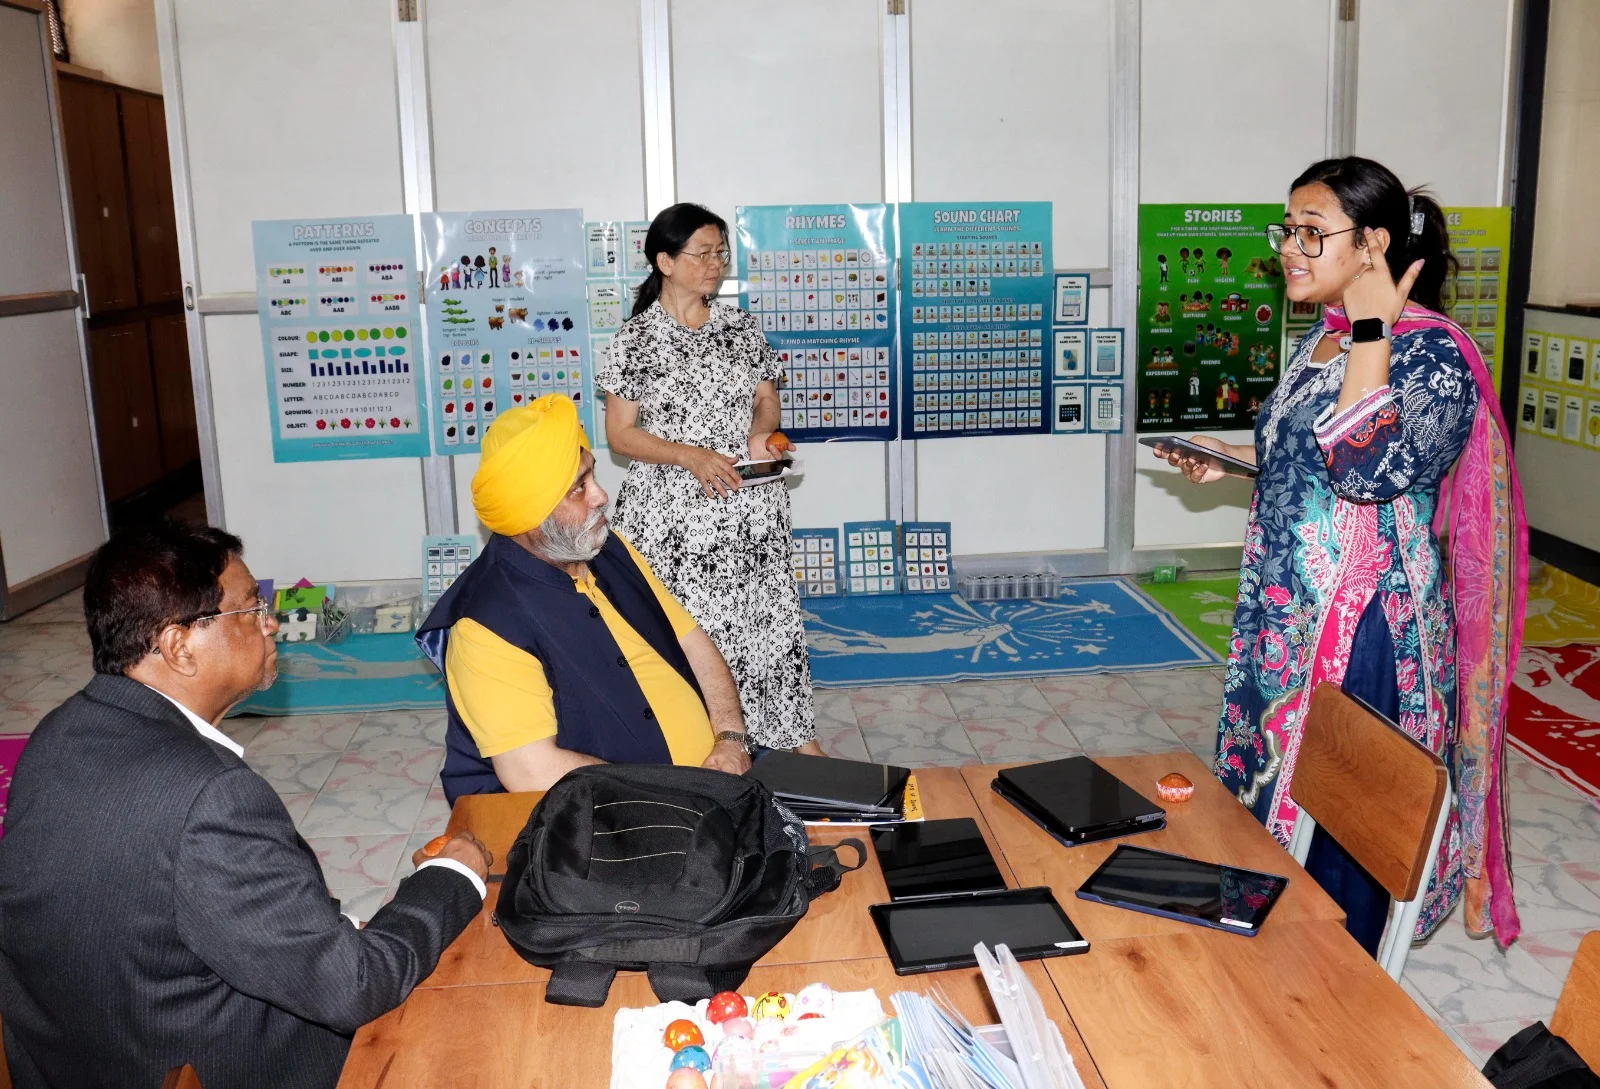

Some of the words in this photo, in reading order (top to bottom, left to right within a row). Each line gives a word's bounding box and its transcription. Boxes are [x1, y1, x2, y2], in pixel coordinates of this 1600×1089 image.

[785, 215, 846, 230] RHYMES
[934, 210, 977, 224] SOUND
[980, 209, 1020, 223] CHART
[1184, 209, 1242, 223] STORIES
[1446, 213, 1461, 225] CE
[293, 222, 376, 240] PATTERNS
[464, 218, 542, 234] CONCEPTS
[1463, 258, 1469, 266] d
